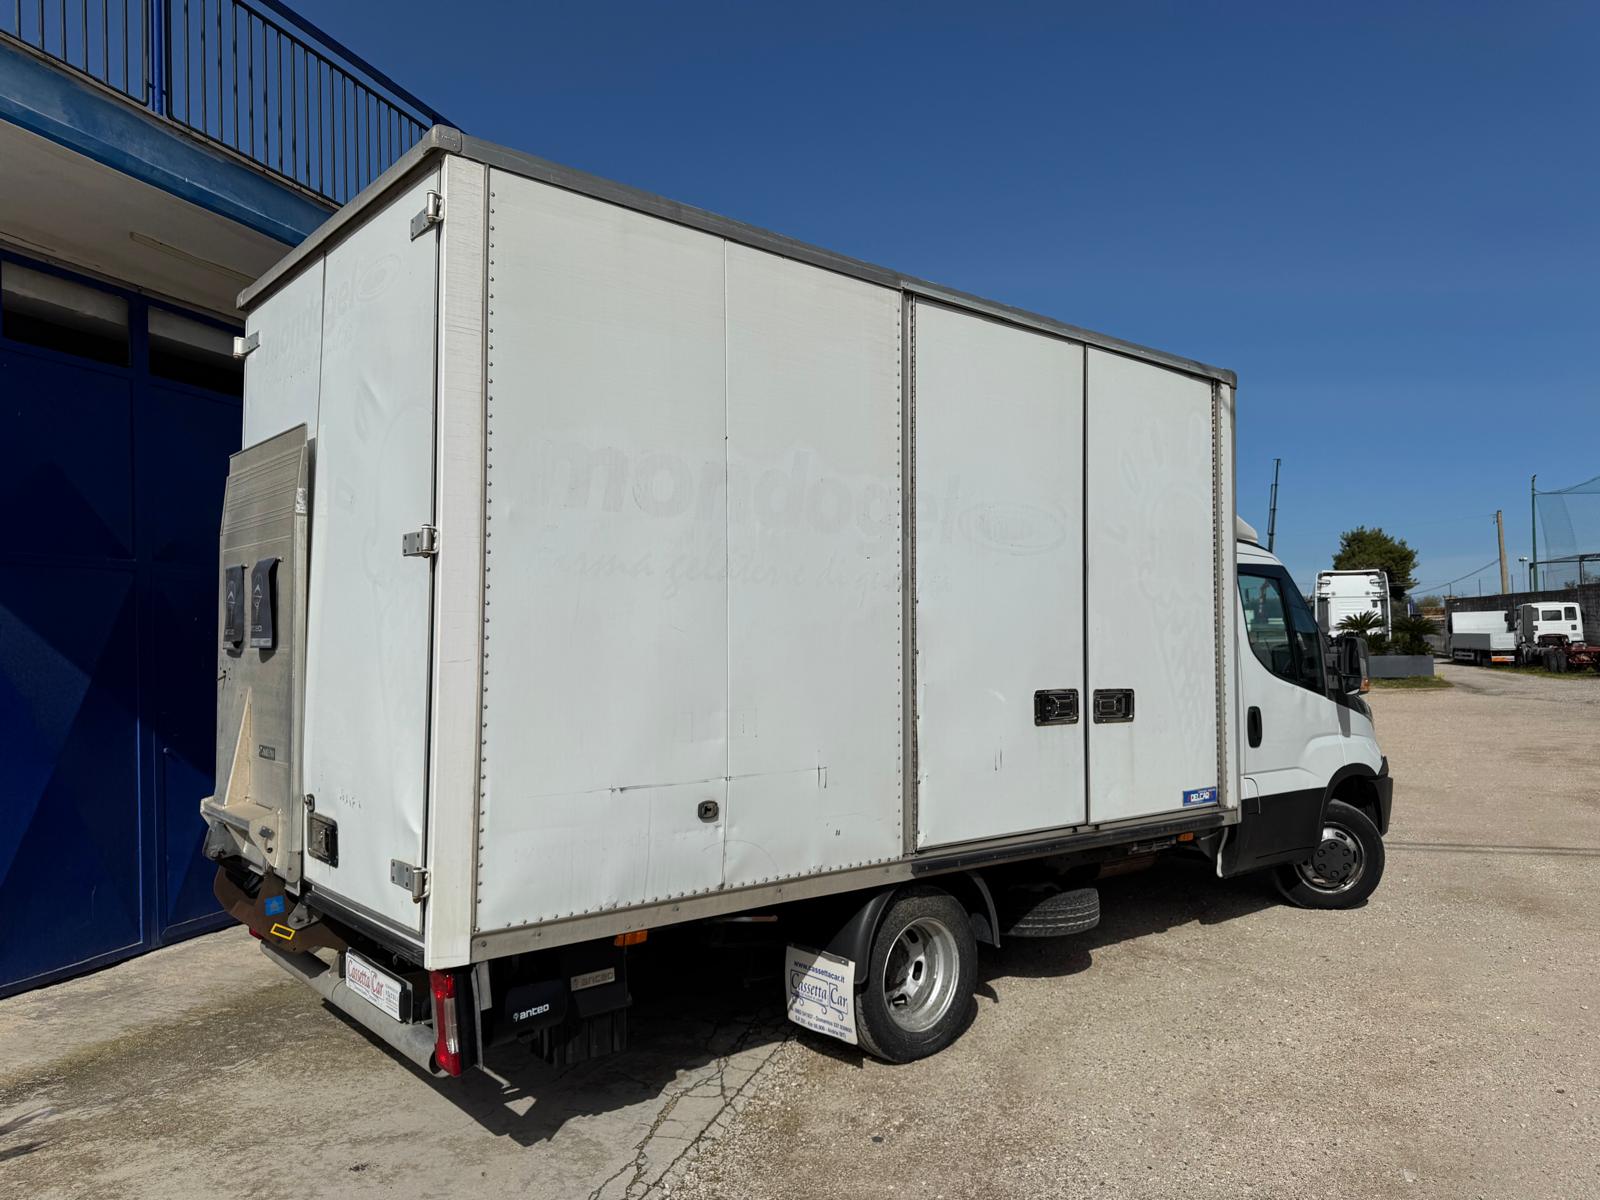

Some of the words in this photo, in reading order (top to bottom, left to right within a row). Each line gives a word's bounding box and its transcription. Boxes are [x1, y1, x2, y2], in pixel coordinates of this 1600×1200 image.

[791, 972, 827, 1000] Cassetta
[830, 987, 848, 1007] Car
[519, 1003, 550, 1020] anteo
